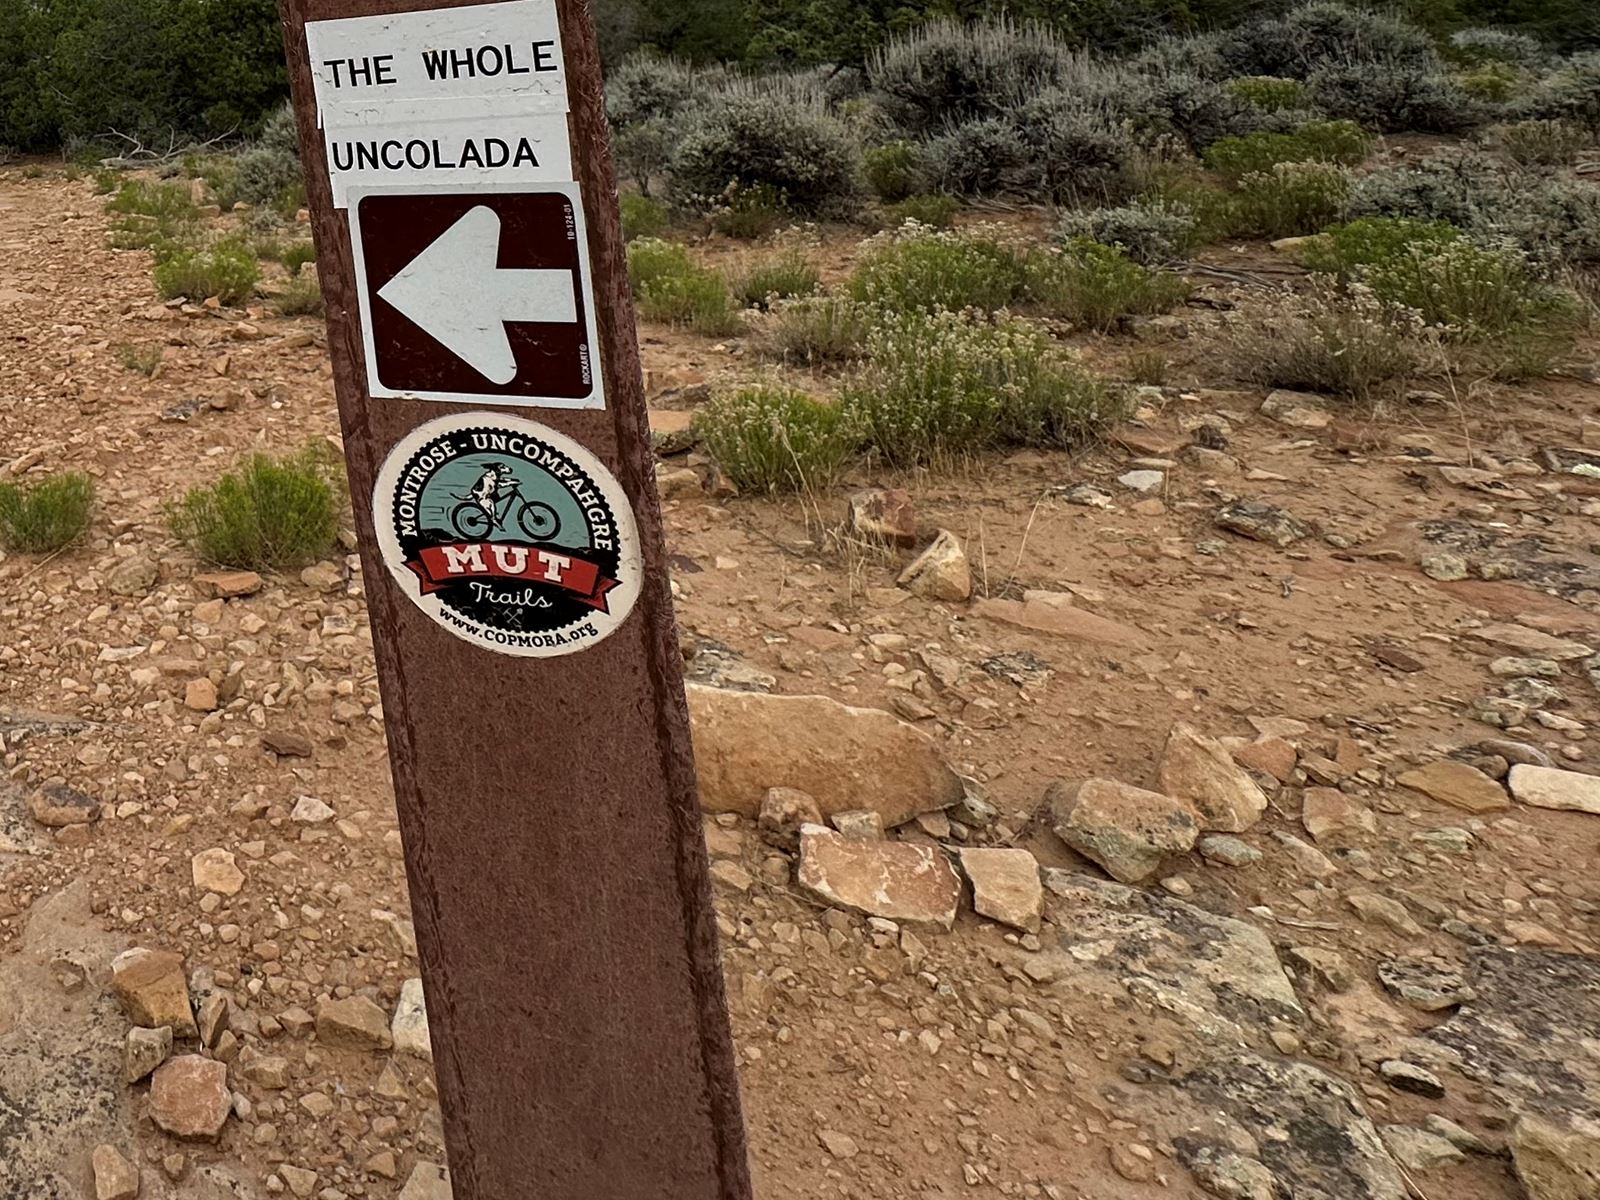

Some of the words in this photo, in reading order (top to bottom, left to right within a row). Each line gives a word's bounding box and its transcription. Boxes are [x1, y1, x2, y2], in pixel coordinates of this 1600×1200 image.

[324, 54, 397, 89] THE
[422, 40, 558, 81] WHOLE
[332, 137, 539, 170] UNCOLADA
[564, 204, 575, 240] 10-124-01
[397, 440, 457, 536] MONTROSE
[472, 433, 613, 551] UNCOMPAHGRE
[442, 544, 571, 583] MUT
[469, 581, 553, 608] Trails
[439, 607, 598, 647] www.COPMOBA.org
